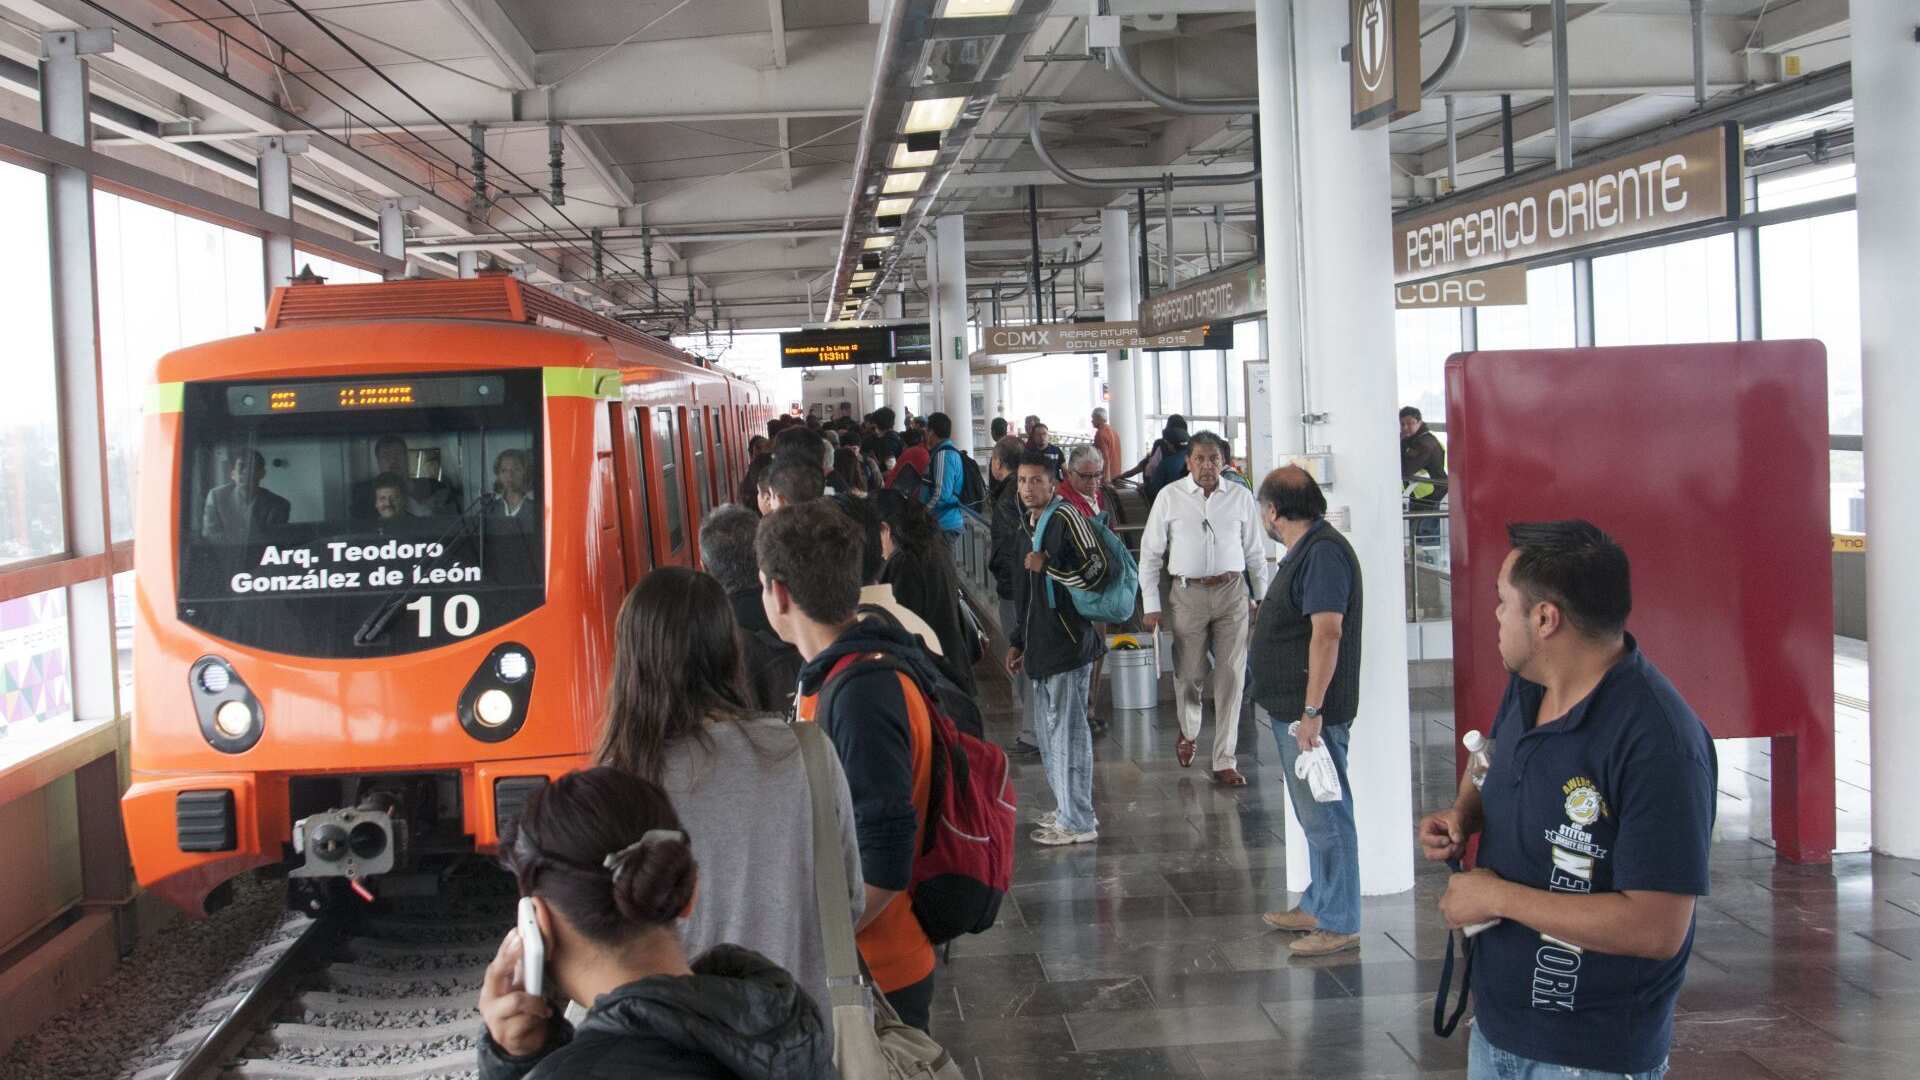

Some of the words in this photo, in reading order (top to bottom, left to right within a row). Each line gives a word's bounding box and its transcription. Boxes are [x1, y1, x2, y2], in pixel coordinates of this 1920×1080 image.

[1406, 196, 1538, 273] PERIFERICO
[1547, 153, 1688, 239] ORIENTE
[1195, 282, 1233, 317] ORIENTE
[993, 331, 1050, 348] CDMX
[1158, 335, 1187, 345] 2015
[259, 545, 319, 568] Arq.
[327, 540, 444, 562] Teodoro
[230, 569, 361, 593] González
[368, 566, 404, 586] de
[412, 562, 482, 585] León
[405, 594, 480, 638] 10
[1559, 823, 1593, 844] STITCH
[1550, 844, 1594, 893] NE
